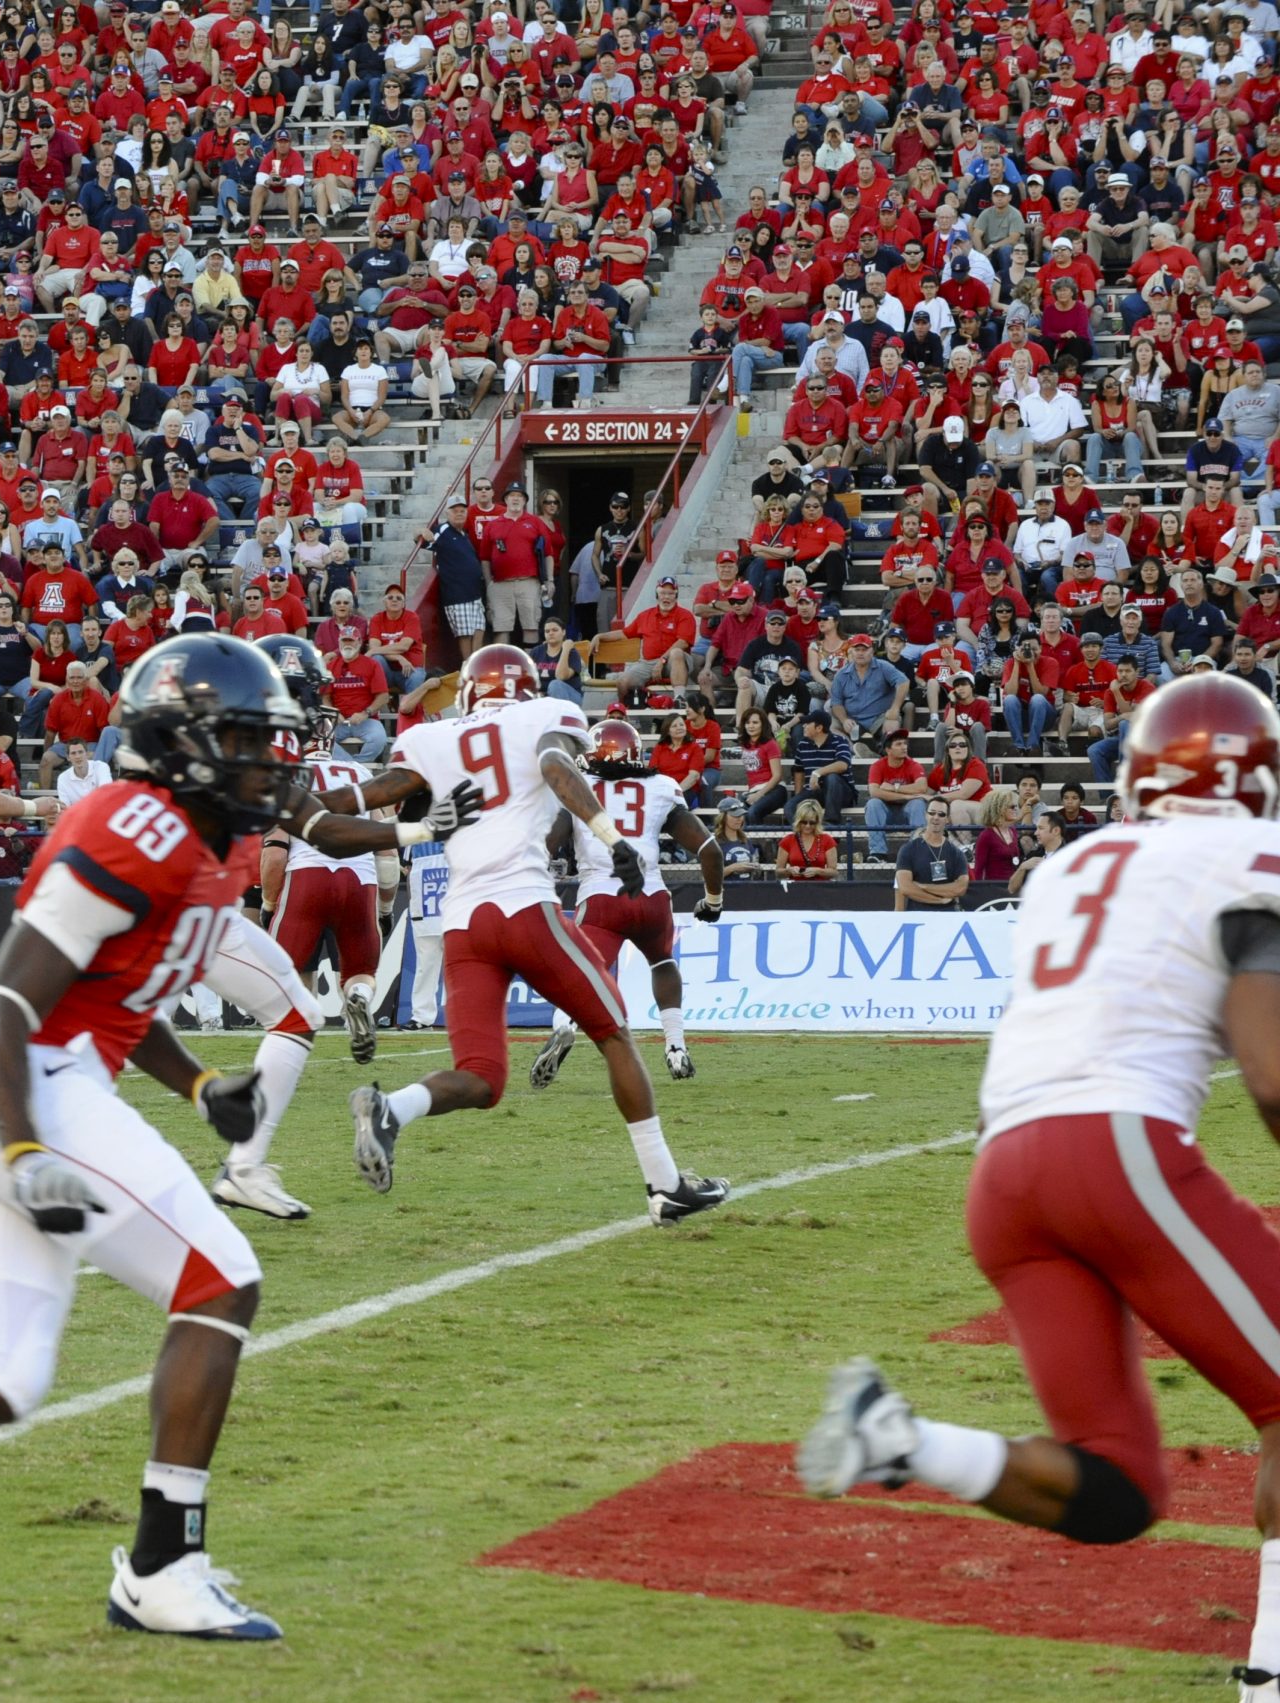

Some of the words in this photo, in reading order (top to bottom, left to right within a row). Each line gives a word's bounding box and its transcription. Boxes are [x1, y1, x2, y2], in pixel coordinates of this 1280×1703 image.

[332, 24, 344, 42] 7
[785, 15, 804, 29] 38
[179, 423, 196, 442] A
[562, 423, 580, 441] 23
[586, 422, 649, 441] SECTION
[654, 422, 672, 440] 24
[40, 582, 65, 606] A
[279, 645, 307, 678] A
[504, 678, 516, 698] 9
[458, 723, 511, 811] 9
[1214, 761, 1238, 798] 3
[592, 781, 645, 837] 13
[107, 793, 188, 862] 89
[424, 883, 448, 895] PA
[1030, 840, 1140, 991] 3
[673, 920, 1016, 984] HUMA
[842, 998, 915, 1019] when
[927, 1005, 976, 1024] you
